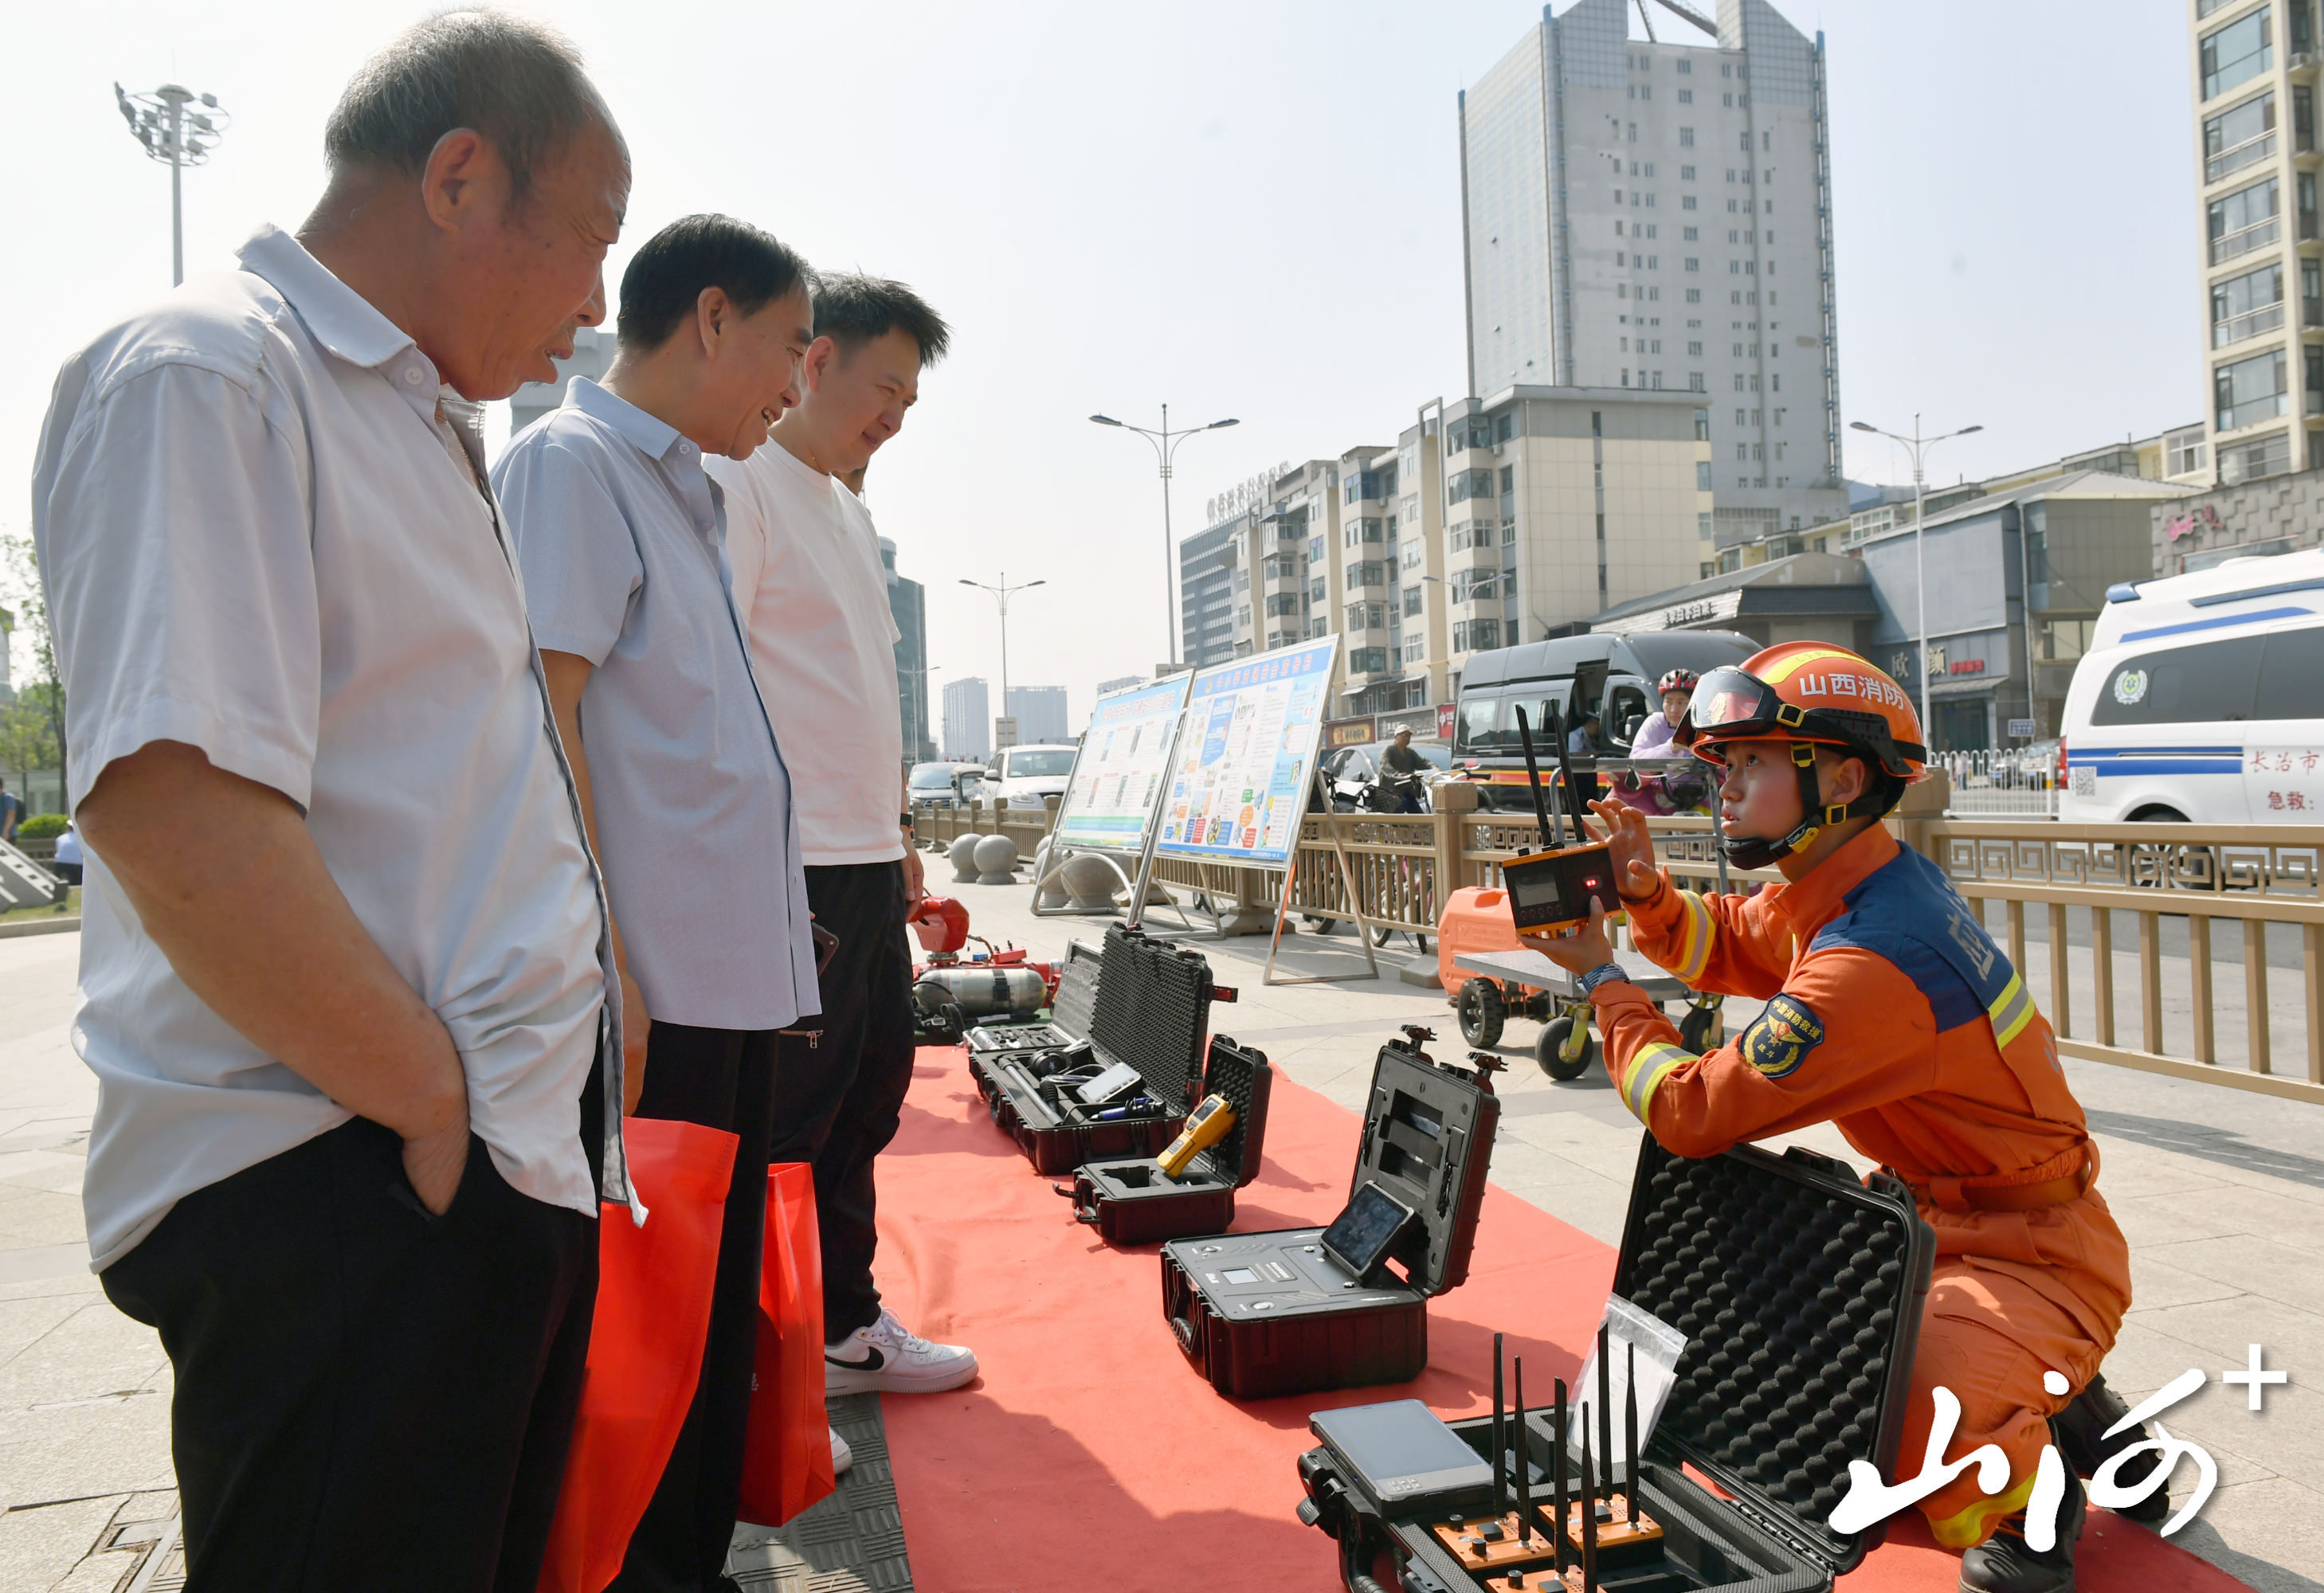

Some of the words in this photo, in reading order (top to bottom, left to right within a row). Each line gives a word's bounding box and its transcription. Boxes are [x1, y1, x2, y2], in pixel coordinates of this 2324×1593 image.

[1217, 652, 1313, 691] 中小学交通安全宣传栏
[1799, 673, 1904, 710] 山西消防
[2250, 750, 2320, 776] 长治市
[1772, 999, 1822, 1039] 中国消防救援
